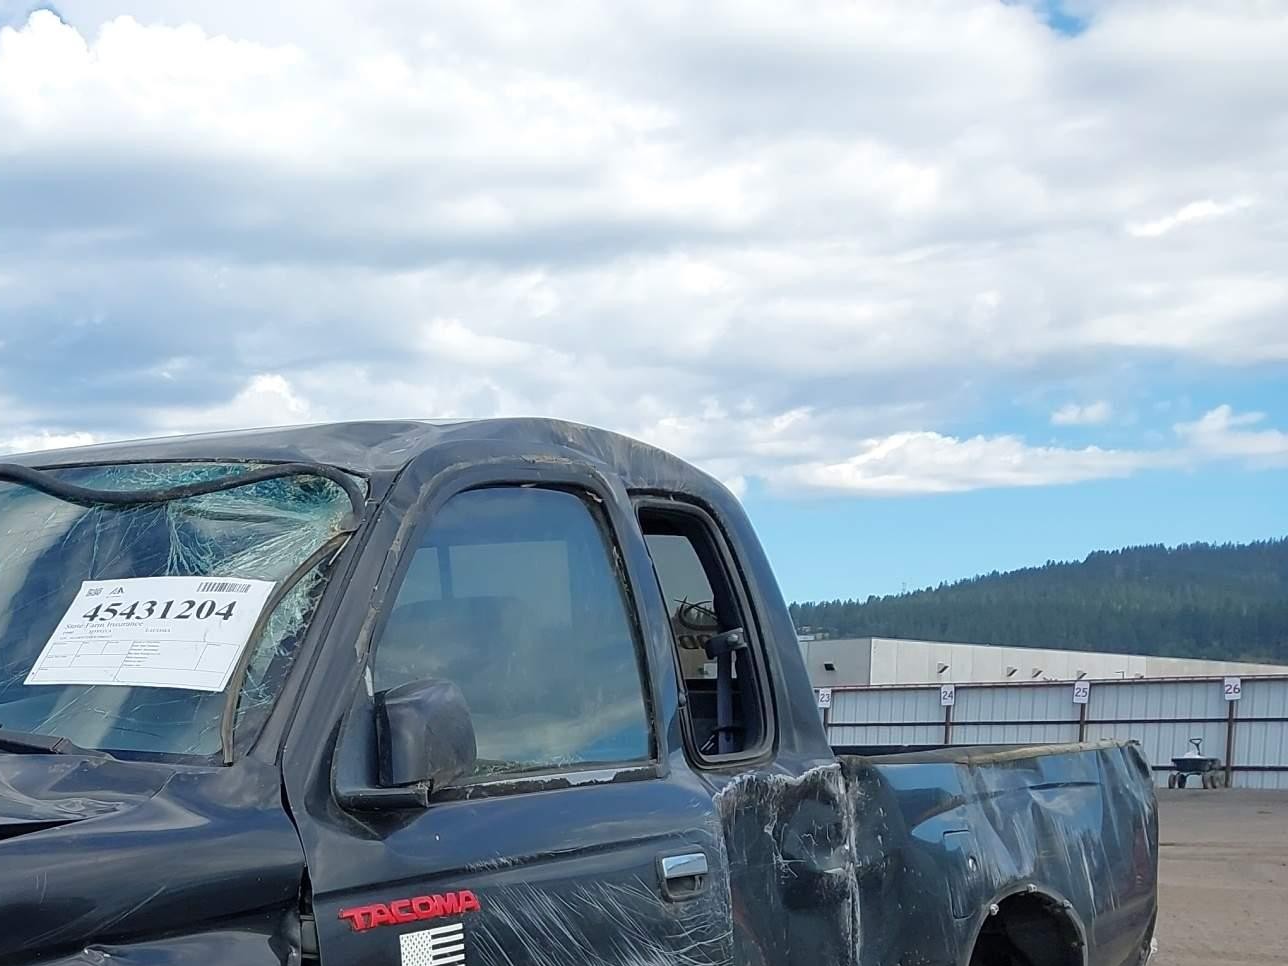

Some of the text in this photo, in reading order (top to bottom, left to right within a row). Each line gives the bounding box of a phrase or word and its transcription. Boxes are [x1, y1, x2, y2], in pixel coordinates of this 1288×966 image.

[82, 599, 237, 622] 45431204
[942, 690, 954, 700] 24
[1075, 687, 1088, 698] 25
[1224, 684, 1241, 695] 26
[820, 693, 830, 703] 23
[339, 889, 480, 931] TACOMA
